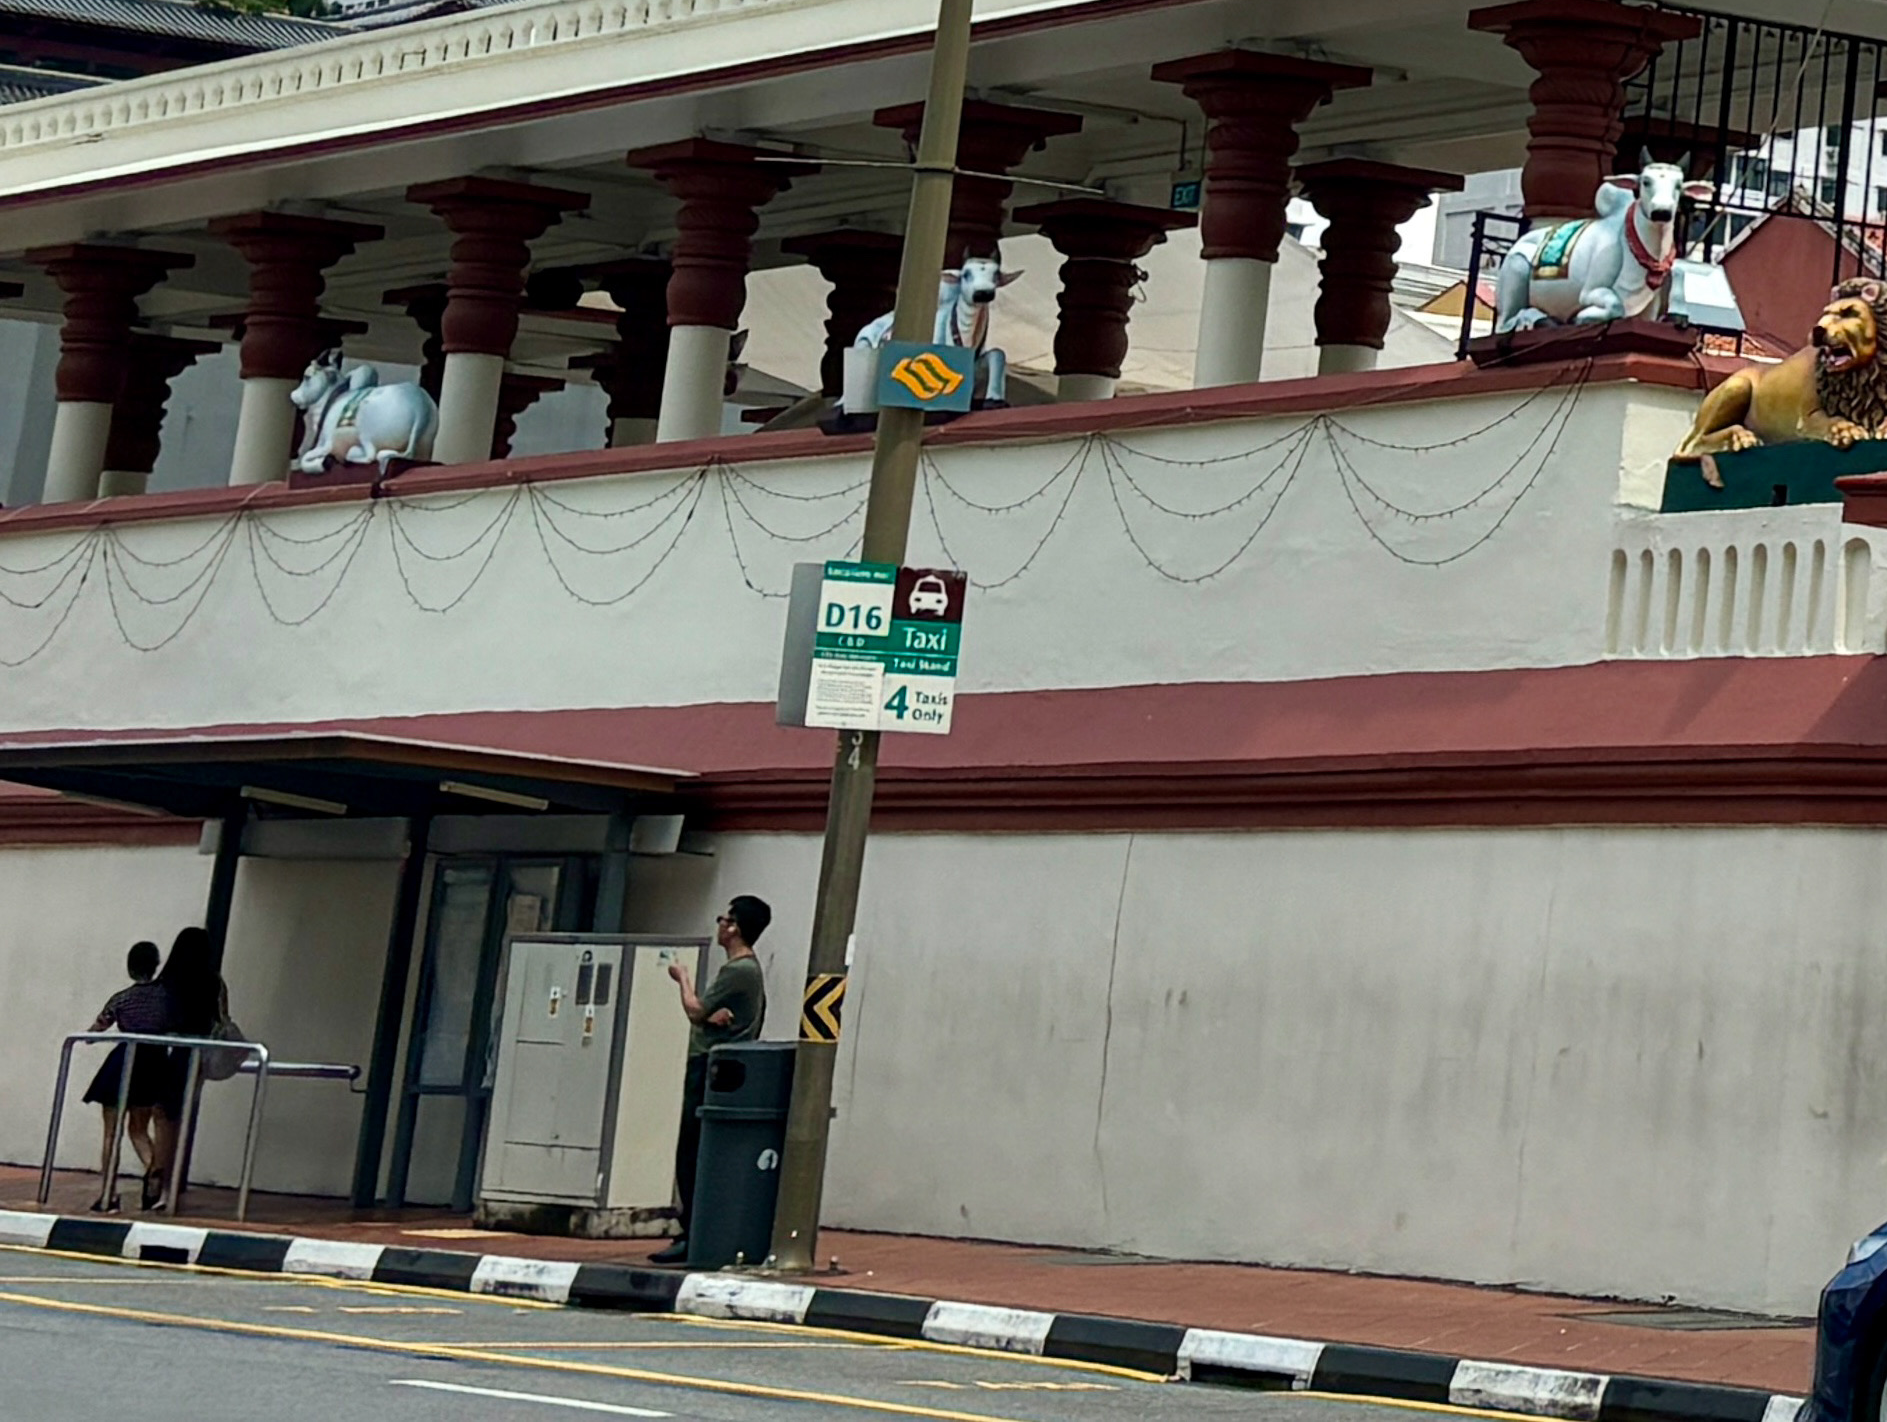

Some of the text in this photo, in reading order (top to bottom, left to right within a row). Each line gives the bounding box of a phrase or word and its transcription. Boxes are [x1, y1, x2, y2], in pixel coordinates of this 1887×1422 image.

[825, 602, 882, 630] D16
[903, 627, 948, 651] Taxi
[894, 658, 950, 671] Taxi Stand
[884, 685, 909, 720] 4
[915, 691, 948, 706] Taxis
[911, 709, 944, 724] Only
